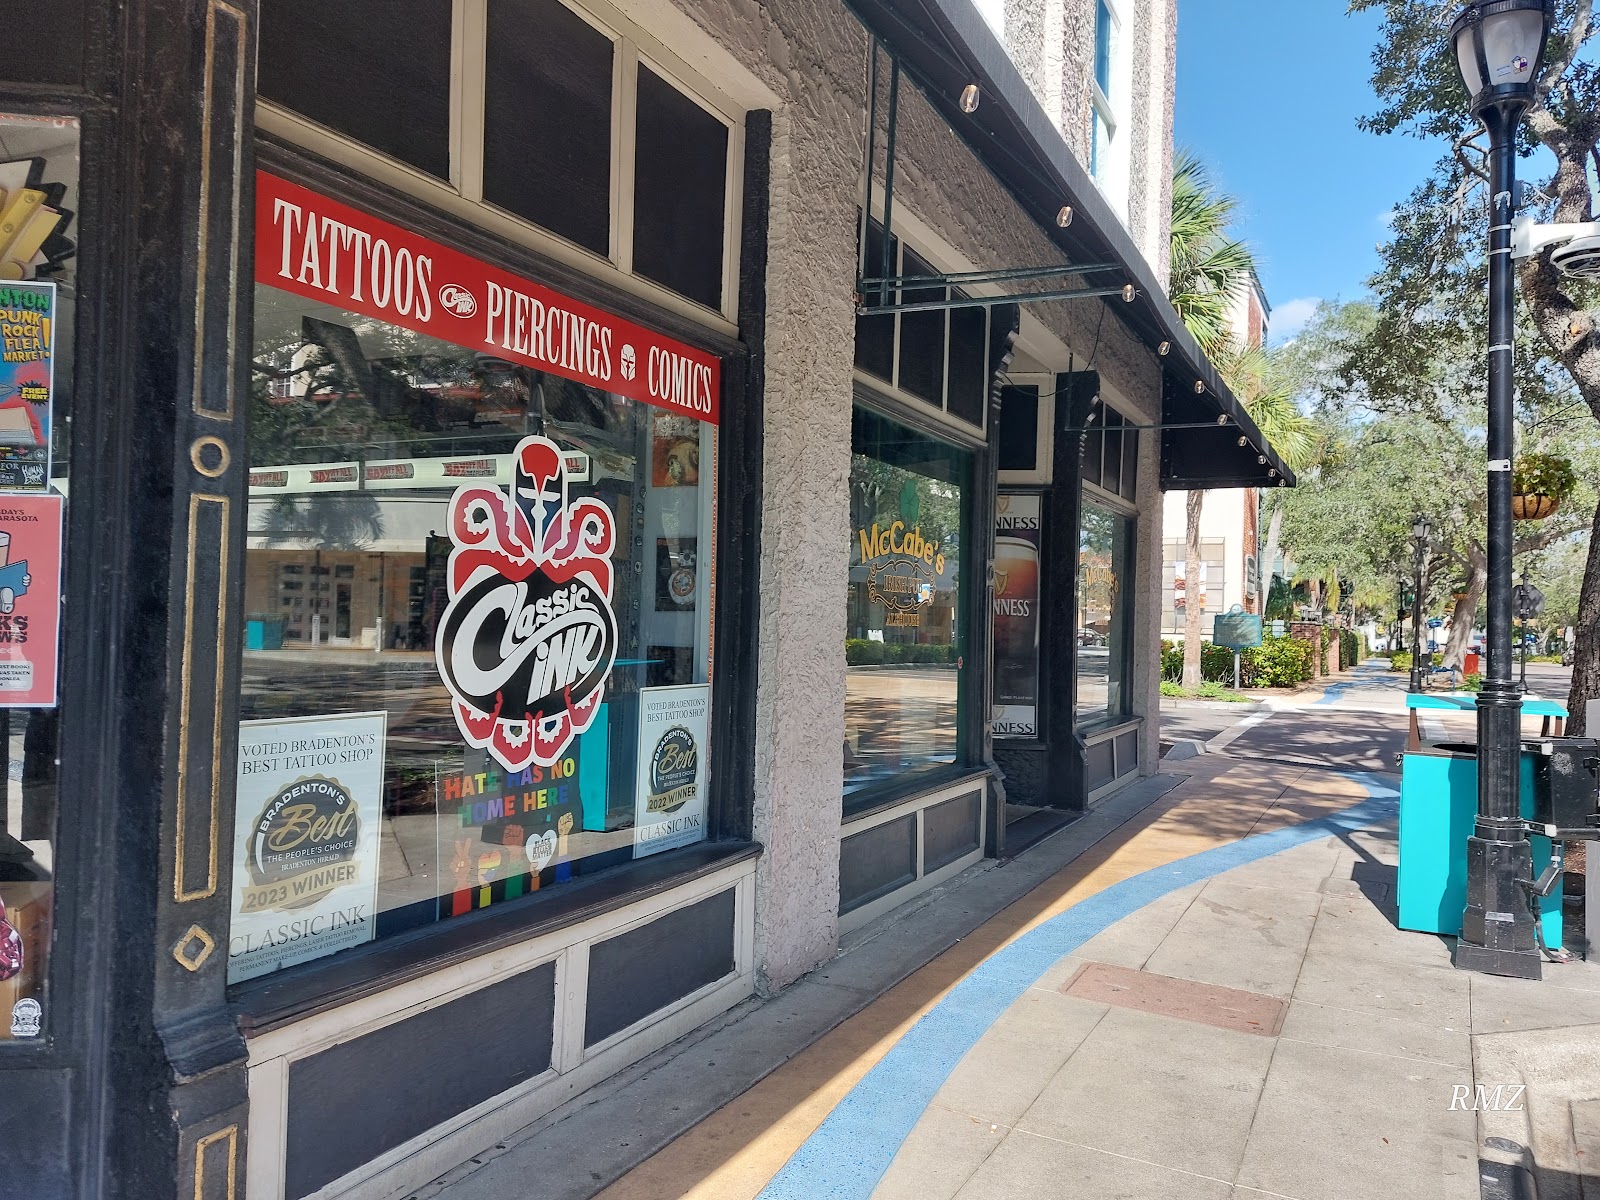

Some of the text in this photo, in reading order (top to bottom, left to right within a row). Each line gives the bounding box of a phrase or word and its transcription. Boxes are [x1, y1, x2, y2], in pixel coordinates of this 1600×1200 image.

[273, 197, 432, 323] TATTOOS
[2, 323, 40, 338] ROCK
[5, 338, 41, 350] FLEA
[484, 280, 712, 414] PIERCINGS COMICS
[859, 520, 945, 576] McCabe's
[451, 581, 604, 697] Classic
[646, 698, 706, 711] VOTED BRADENTON'S
[647, 708, 705, 723] BEST TATTOO SHOP
[241, 734, 376, 757] VOTED BRADENTON'S
[655, 730, 692, 761] BRADENTON'S
[658, 743, 697, 774] Best
[242, 749, 374, 775] BEST TATTOO SHOP
[444, 757, 575, 800] HATE HAS NO
[259, 783, 346, 832] BRADENTON'S
[457, 785, 569, 824] HOME HERE
[648, 786, 696, 810] 2022 WINNER
[268, 803, 355, 852] Best
[640, 818, 682, 842] CLASSIC
[684, 813, 700, 830] INK
[267, 840, 354, 863] THE PEOPLE'S CHOICE
[281, 854, 340, 871] BRADENTON HERALD
[247, 864, 356, 908] 2023 WINNER
[229, 904, 367, 958] CLASSIC INK
